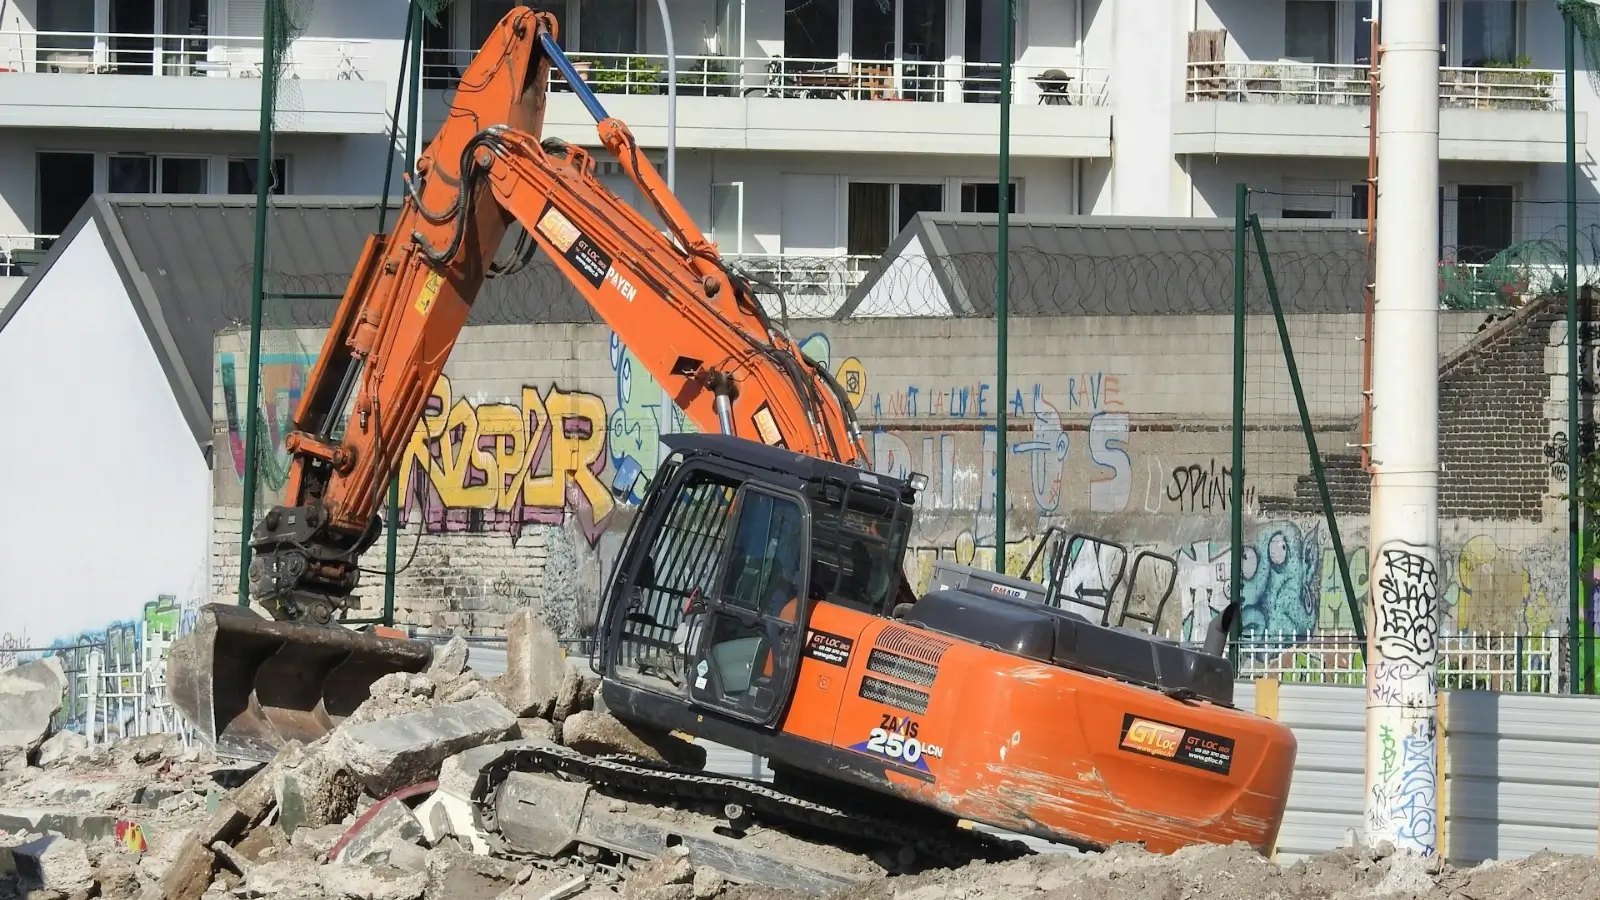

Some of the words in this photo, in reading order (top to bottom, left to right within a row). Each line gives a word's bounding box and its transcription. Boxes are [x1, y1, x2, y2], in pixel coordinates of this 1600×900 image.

[578, 240, 589, 250] GT
[587, 248, 600, 262] LOC
[605, 266, 637, 303] PAYEN
[1069, 371, 1124, 411] RAVE
[814, 634, 826, 644] GT
[825, 637, 840, 647] LOC
[880, 714, 919, 738] ZAXIS
[867, 727, 921, 763] 250
[921, 742, 944, 759] LCN
[1187, 736, 1201, 745] GT
[1202, 740, 1218, 750] LOC
